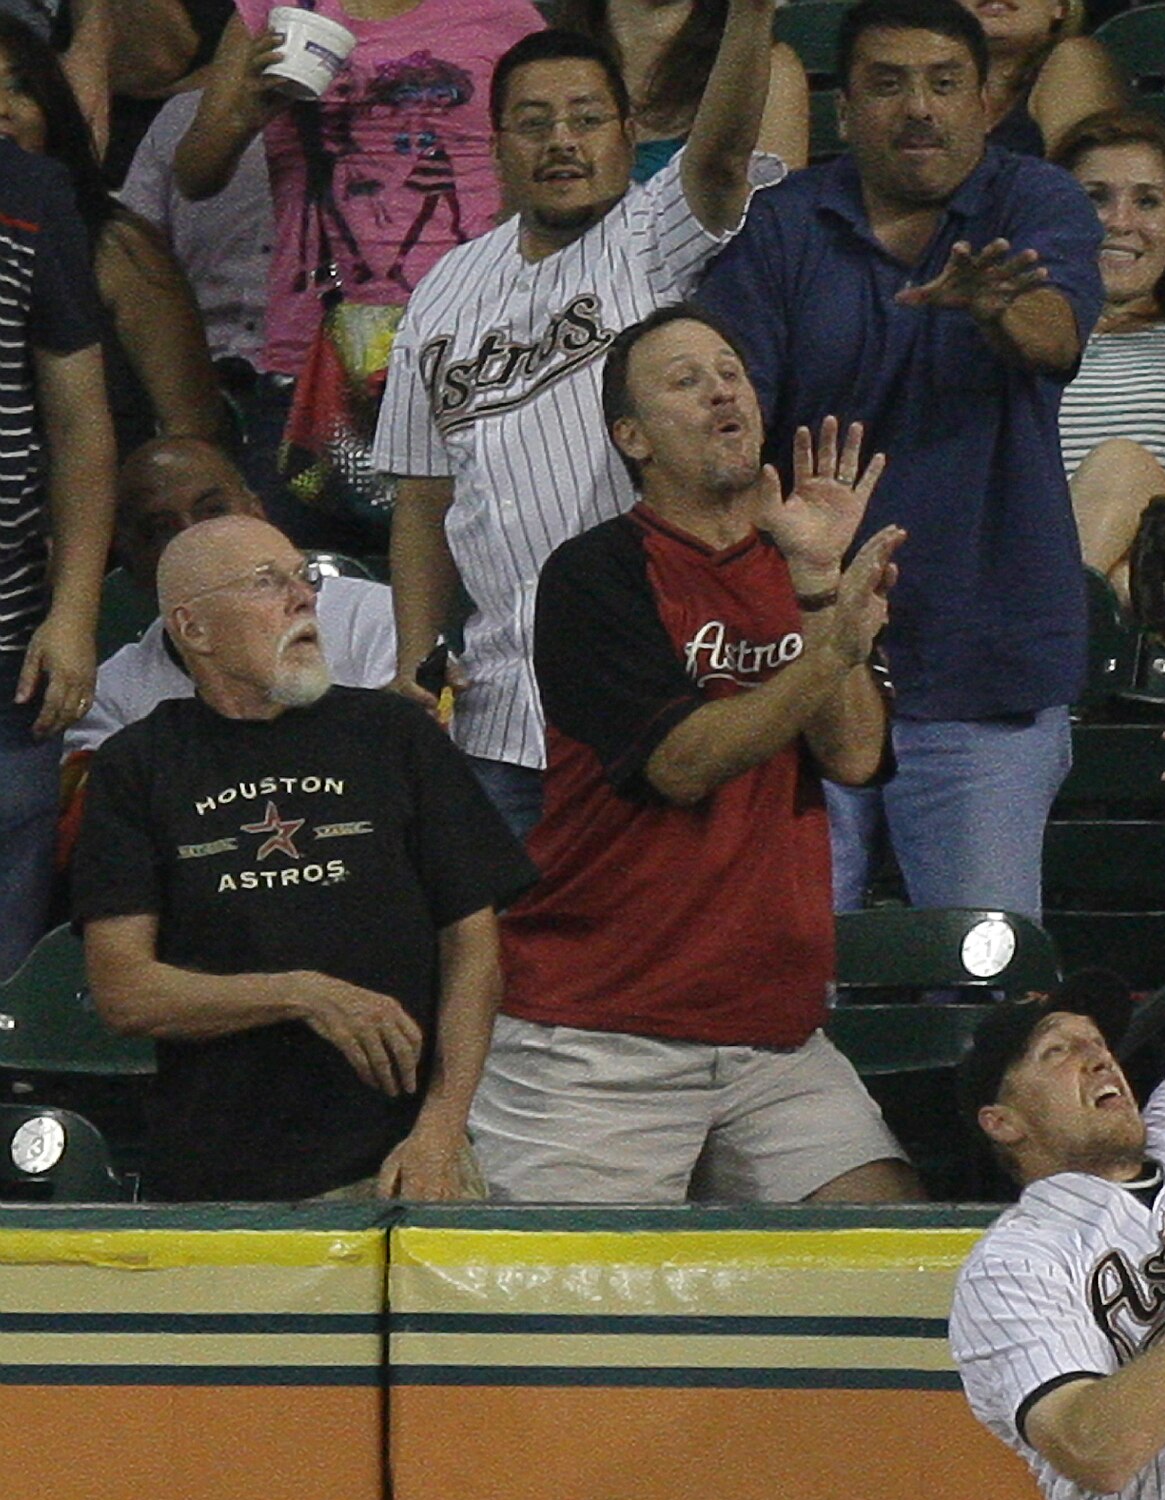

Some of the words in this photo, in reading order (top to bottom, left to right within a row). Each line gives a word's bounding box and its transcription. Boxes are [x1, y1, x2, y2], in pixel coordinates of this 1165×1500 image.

[684, 621, 803, 680] Astro
[194, 776, 345, 816] HOUSTON
[217, 859, 346, 893] ASTROS
[30, 1136, 45, 1158] 3
